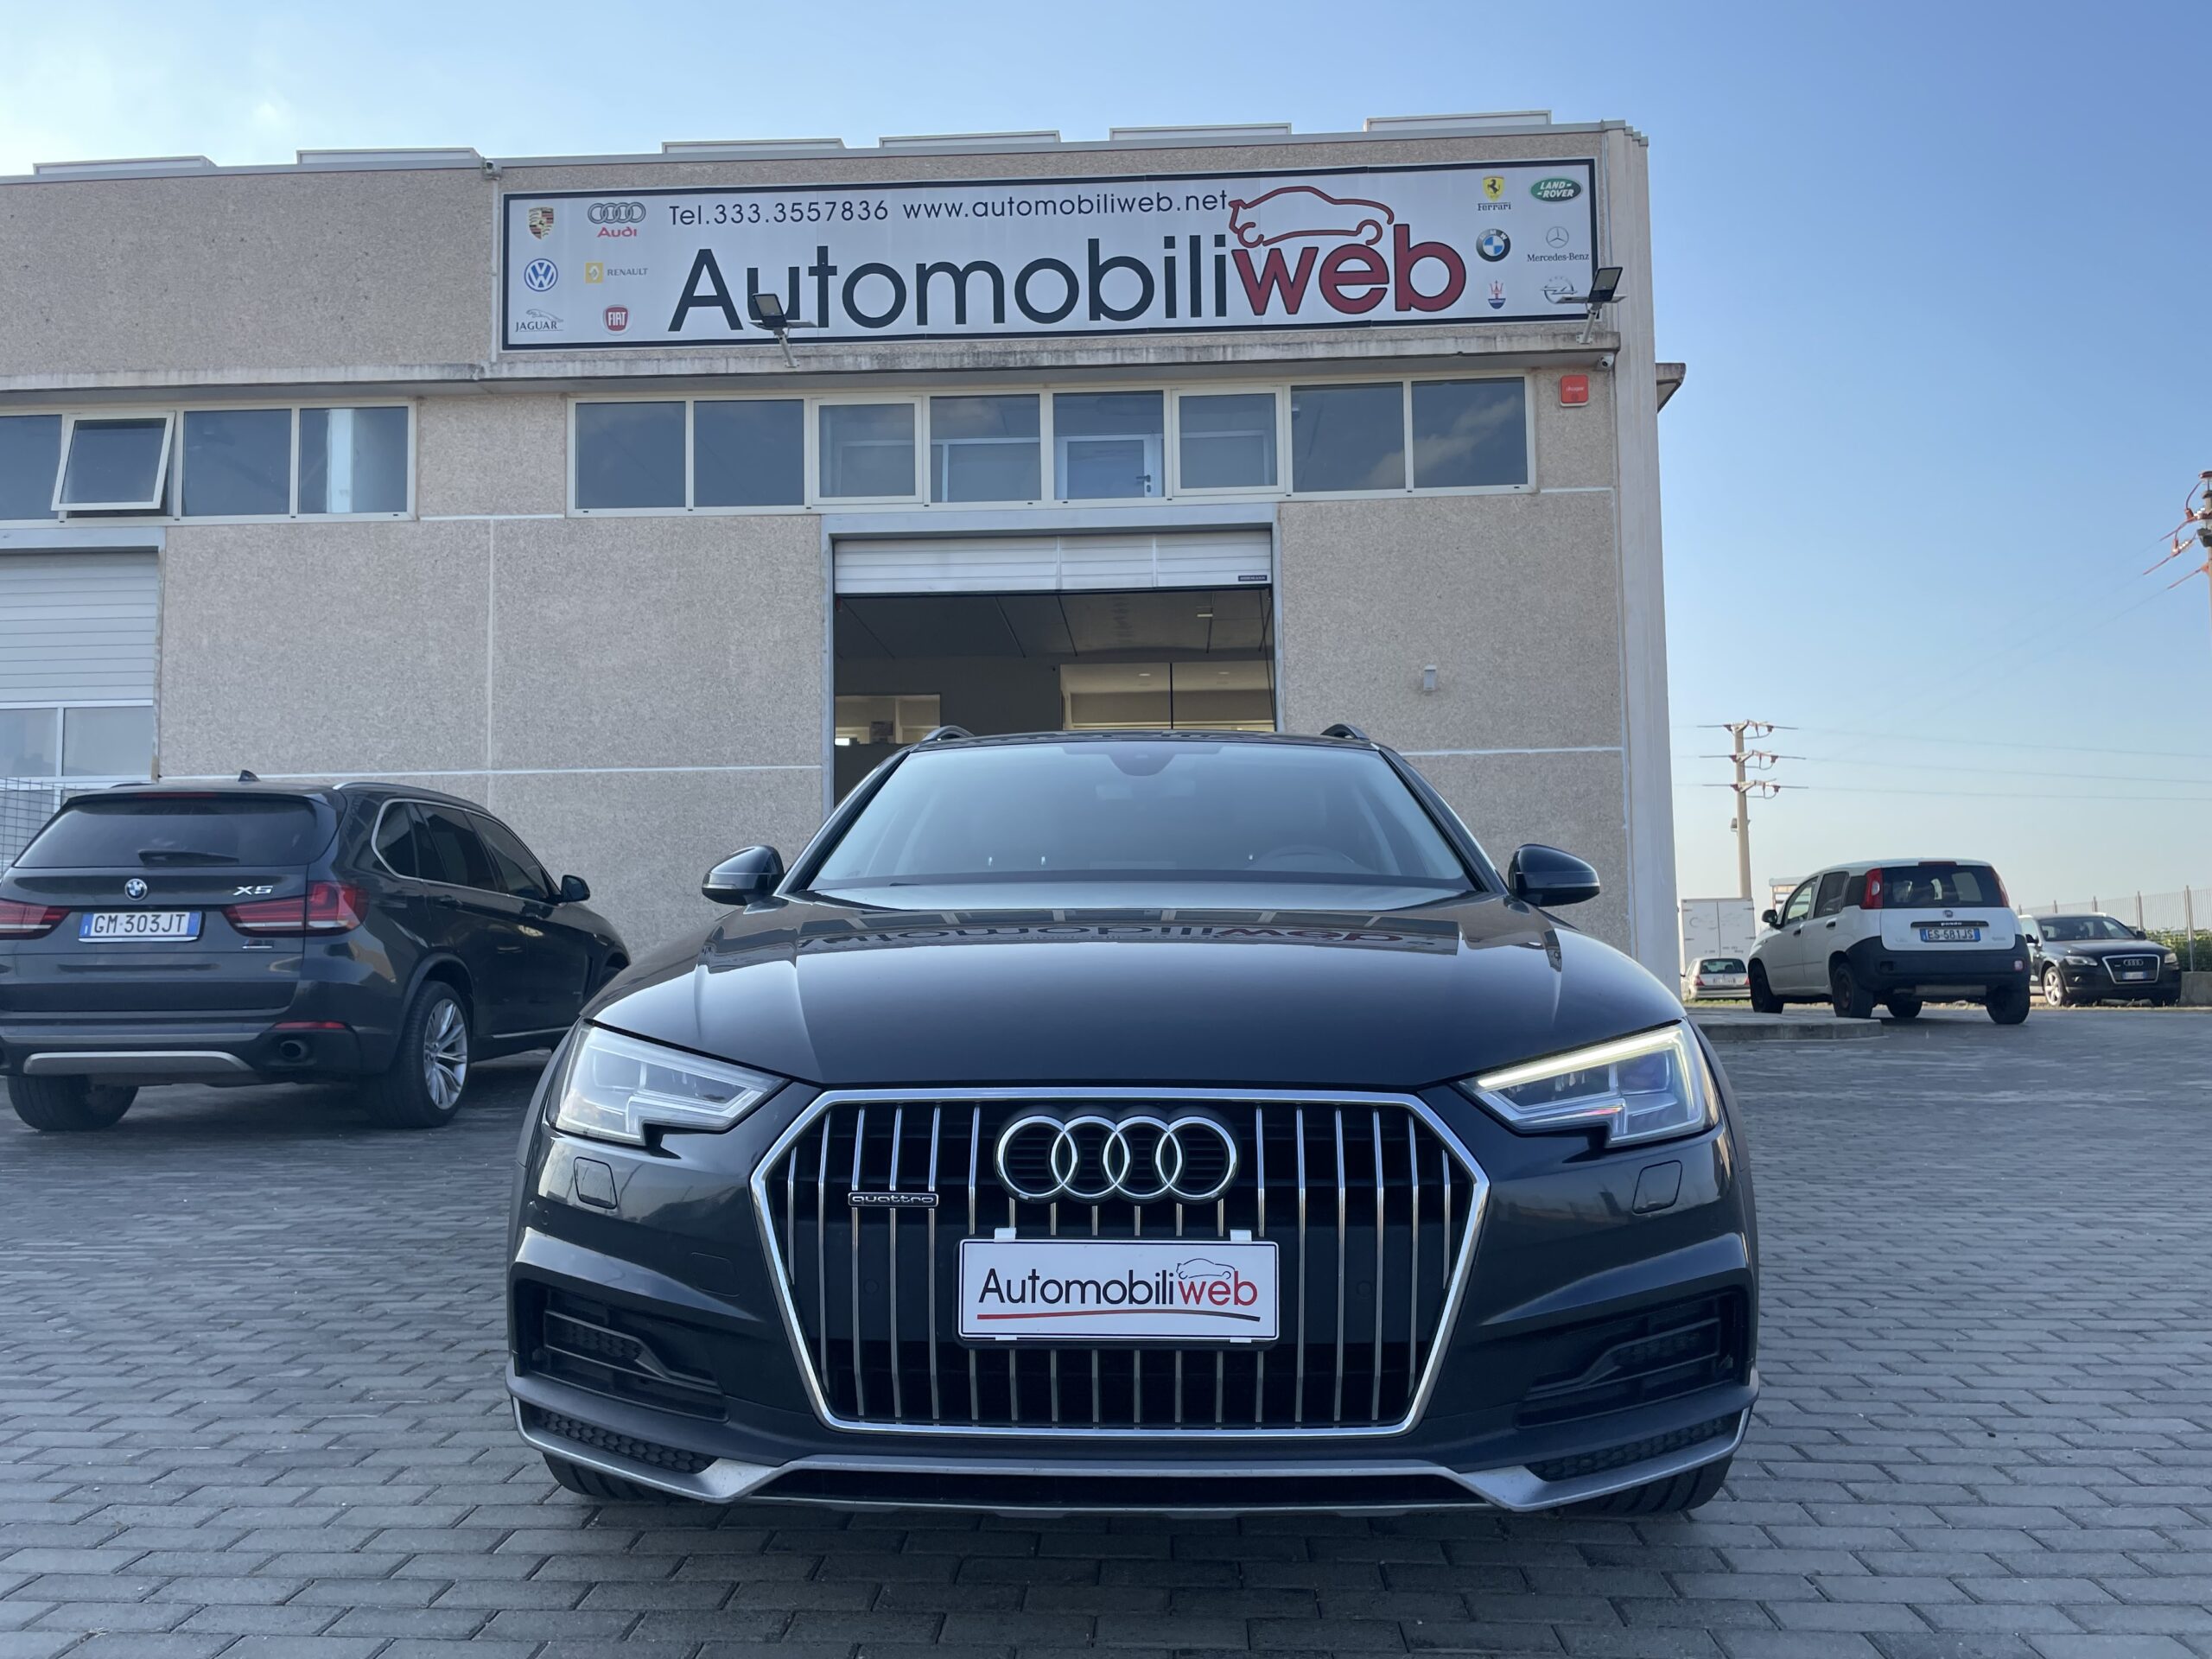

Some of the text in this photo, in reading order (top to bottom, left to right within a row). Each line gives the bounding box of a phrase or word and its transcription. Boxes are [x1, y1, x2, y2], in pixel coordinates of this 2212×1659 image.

[670, 189, 1228, 226] Tel.333.3557836 www.automobiliweb.net
[1477, 202, 1511, 211] Ferrari
[596, 226, 638, 238] Audi
[1527, 252, 1590, 263] Mercedes-Benz
[607, 267, 649, 276] RENAULT
[607, 311, 626, 327] FIAT
[514, 320, 558, 333] JAGUAR
[233, 885, 274, 896] X5
[93, 913, 187, 934] GM 303JT
[1927, 929, 1941, 939] ES
[850, 1194, 936, 1205] quattro
[978, 1268, 1259, 1306] Automobiliweb
